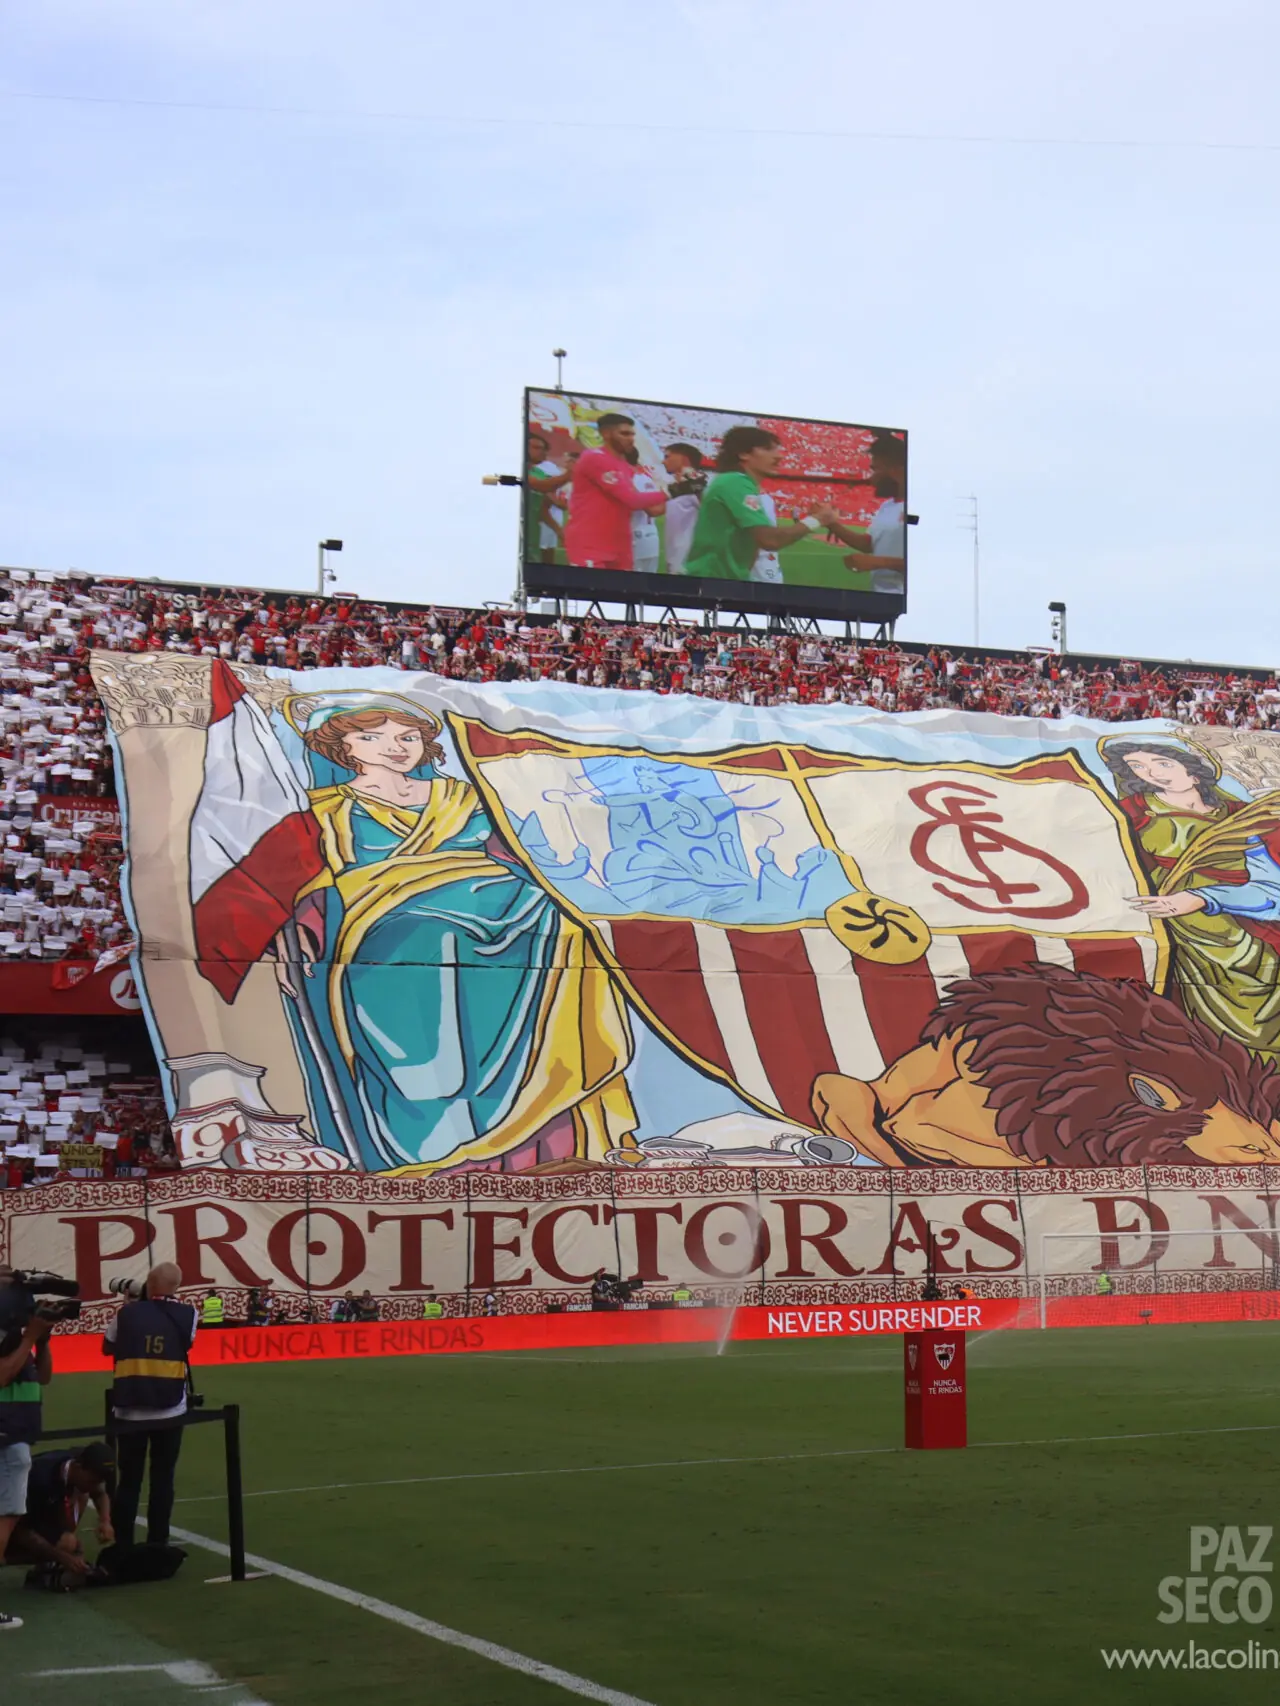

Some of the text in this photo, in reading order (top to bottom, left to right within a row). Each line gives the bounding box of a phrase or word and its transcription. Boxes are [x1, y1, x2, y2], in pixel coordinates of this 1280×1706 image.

[40, 803, 122, 826] Cruzca
[58, 1198, 1025, 1301] PROTECTORAS
[768, 1305, 982, 1333] NEVER SURRENDER
[220, 1323, 485, 1360] NUNCA TE RINDAS
[927, 1387, 937, 1395] TE
[938, 1386, 963, 1394] RINDAS
[933, 1379, 957, 1388] NUNCA
